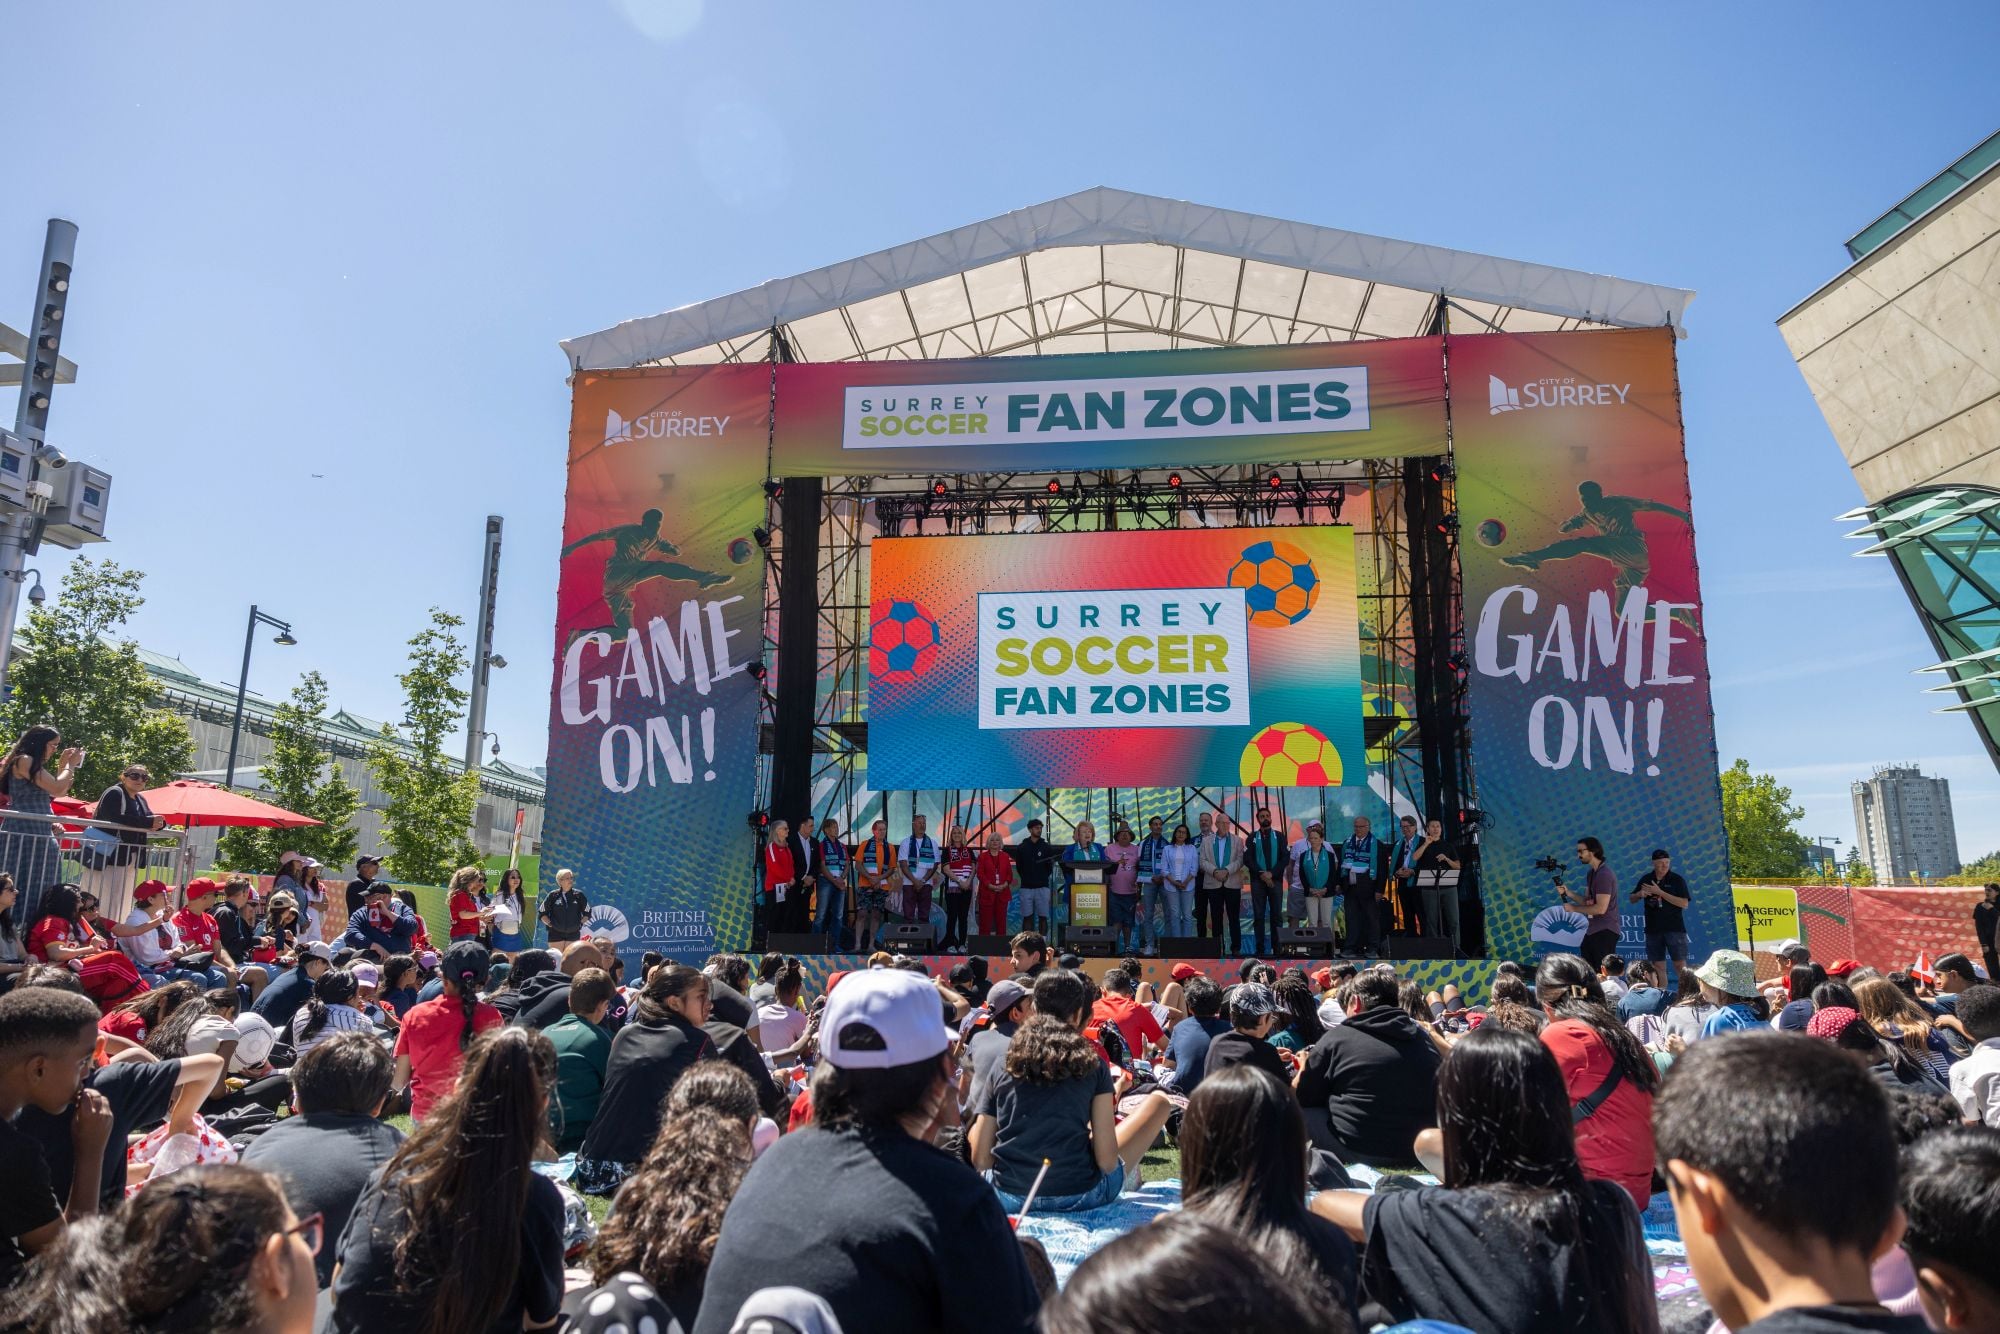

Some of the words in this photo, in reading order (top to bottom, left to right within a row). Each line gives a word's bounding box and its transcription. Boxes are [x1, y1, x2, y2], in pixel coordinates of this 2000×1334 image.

[861, 395, 988, 412] SURREY
[1007, 391, 1125, 432] FAN
[1144, 381, 1351, 428] ZONES
[1523, 383, 1631, 407] SURREY
[635, 416, 730, 438] SURREY
[859, 413, 988, 437] SOCCER
[996, 602, 1222, 629] SURREY
[1475, 584, 1698, 689] GAME
[560, 595, 751, 725] GAME
[994, 634, 1229, 677] SOCCER
[995, 686, 1076, 716] FAN
[1090, 684, 1231, 714] ZONES
[1528, 694, 1664, 777] ON!
[600, 707, 716, 794] ON!
[642, 910, 706, 924] BRITISH
[1751, 918, 1773, 927] EXIT
[632, 924, 714, 938] COLUMBIA
